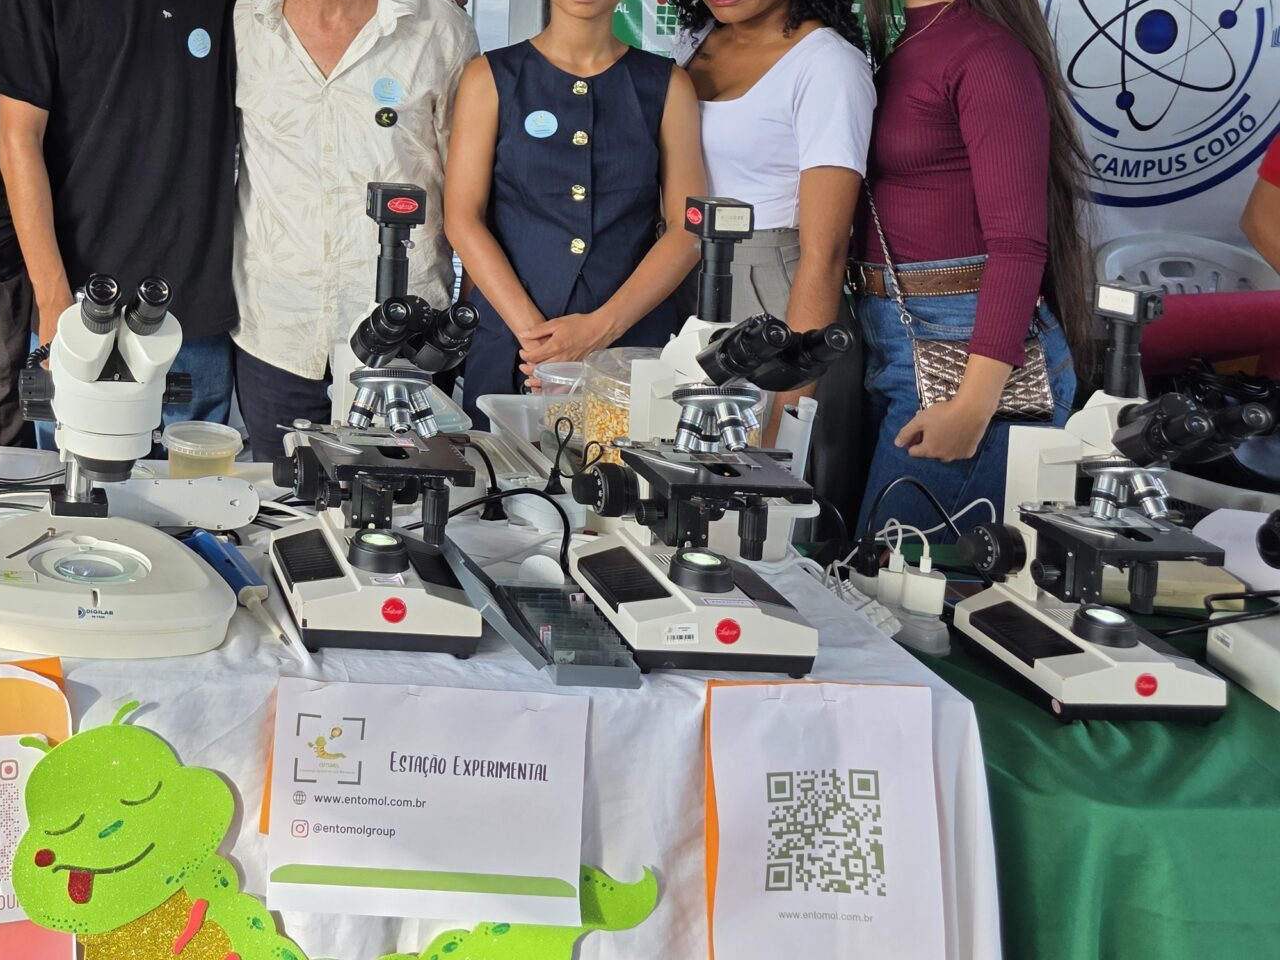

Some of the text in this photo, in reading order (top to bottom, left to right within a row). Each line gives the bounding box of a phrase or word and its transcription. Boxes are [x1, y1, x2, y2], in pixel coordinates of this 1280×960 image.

[1092, 111, 1257, 178] CAMPUS CODÓ
[314, 793, 426, 809] www.entomol.com.br
[312, 823, 396, 838] @entomolgroup
[778, 910, 873, 923] www.entomol.com.br
